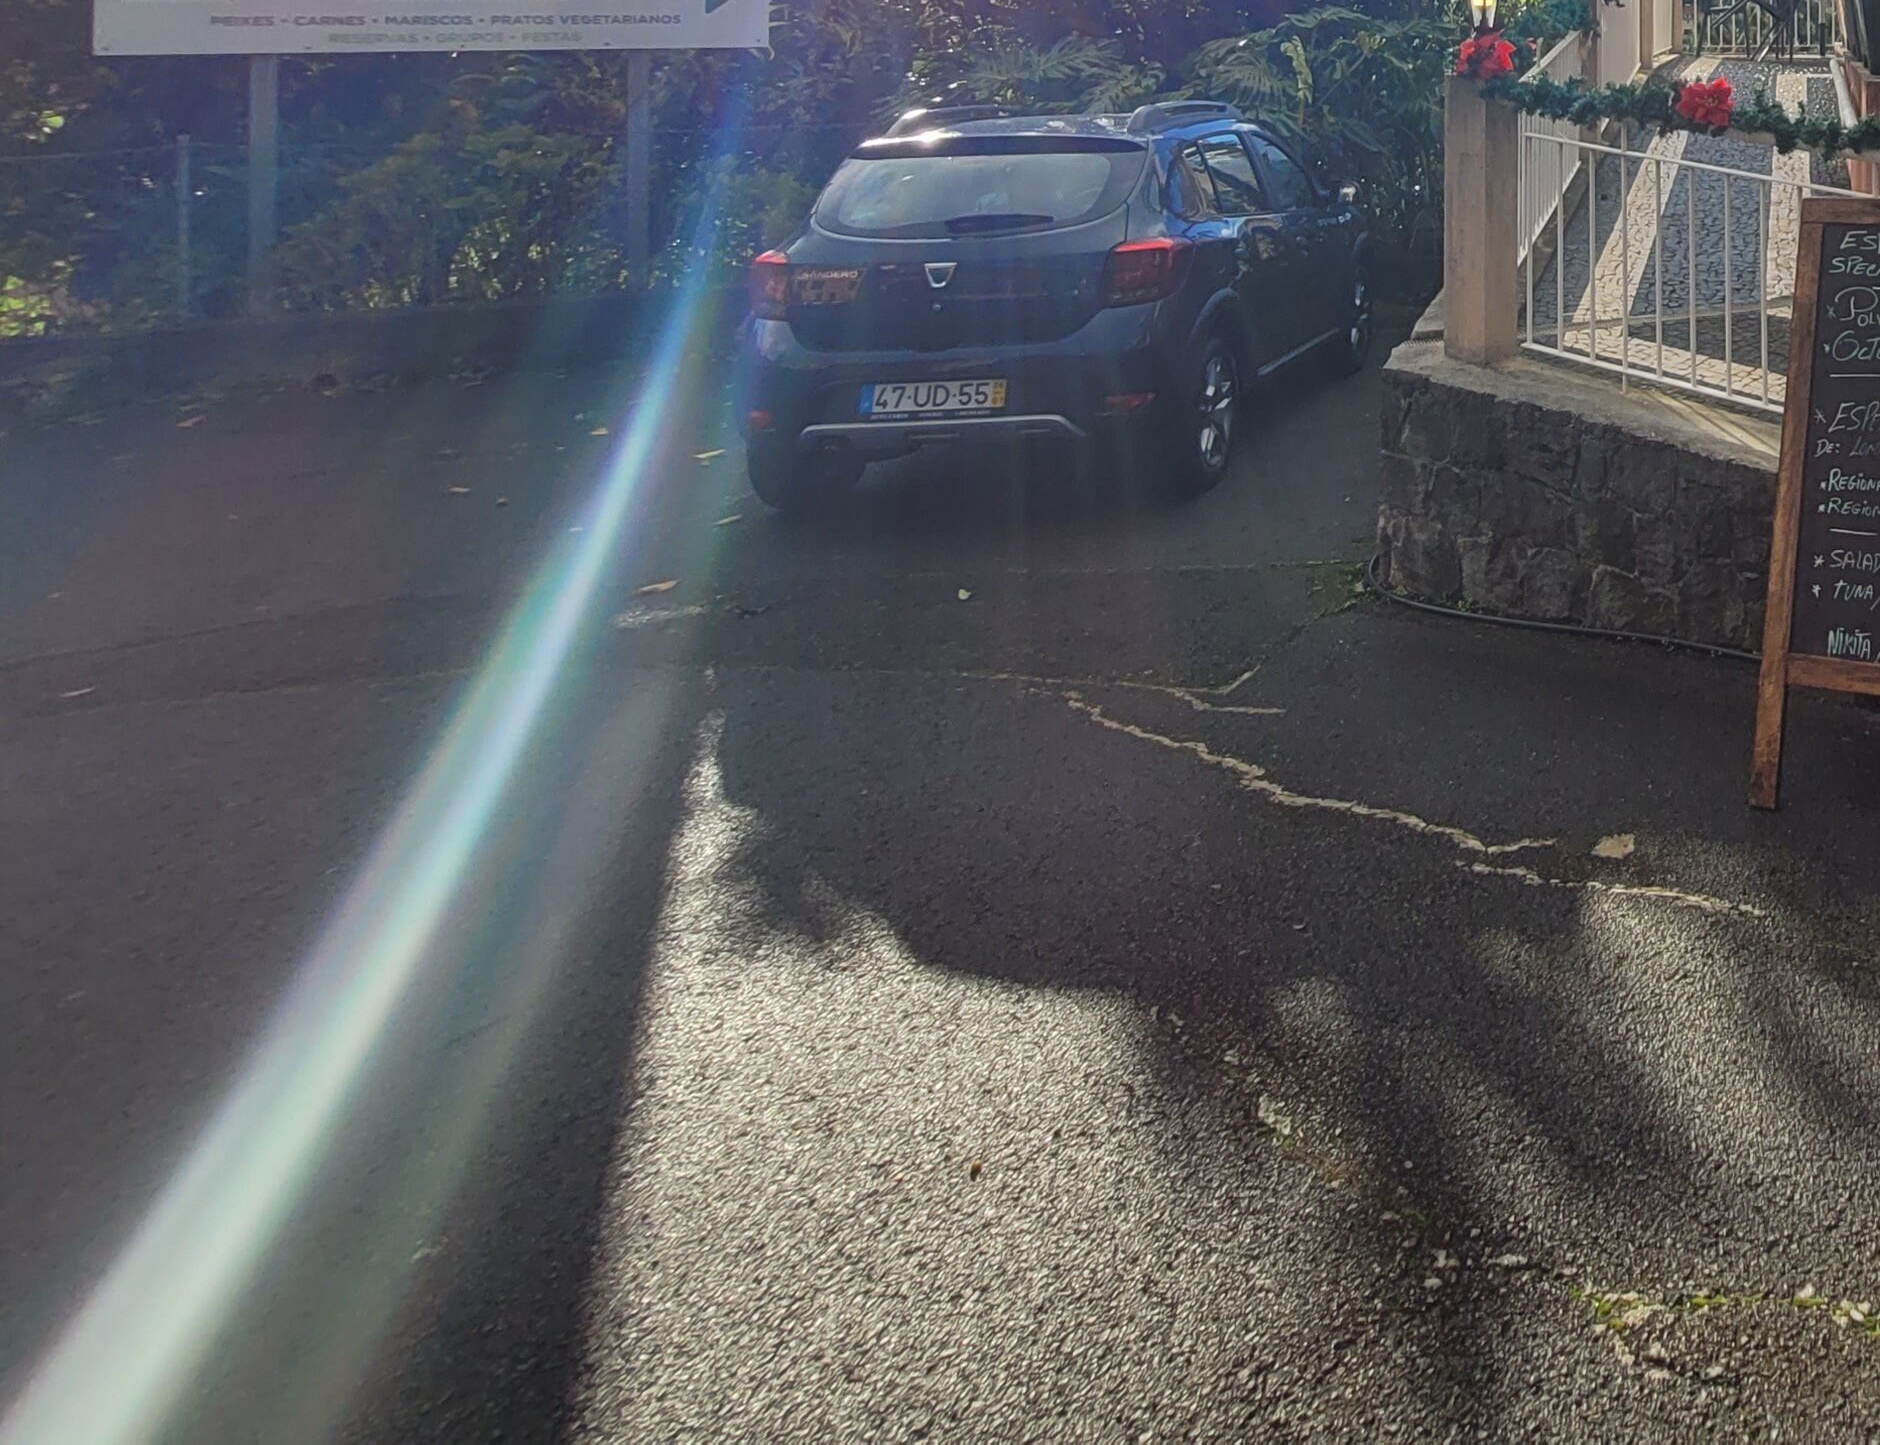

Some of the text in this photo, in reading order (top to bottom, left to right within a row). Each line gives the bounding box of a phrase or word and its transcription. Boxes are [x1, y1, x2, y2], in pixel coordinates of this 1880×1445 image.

[210, 14, 682, 26] PEIXES CARNES MARISCOS PRATOS VEGETARIANOS
